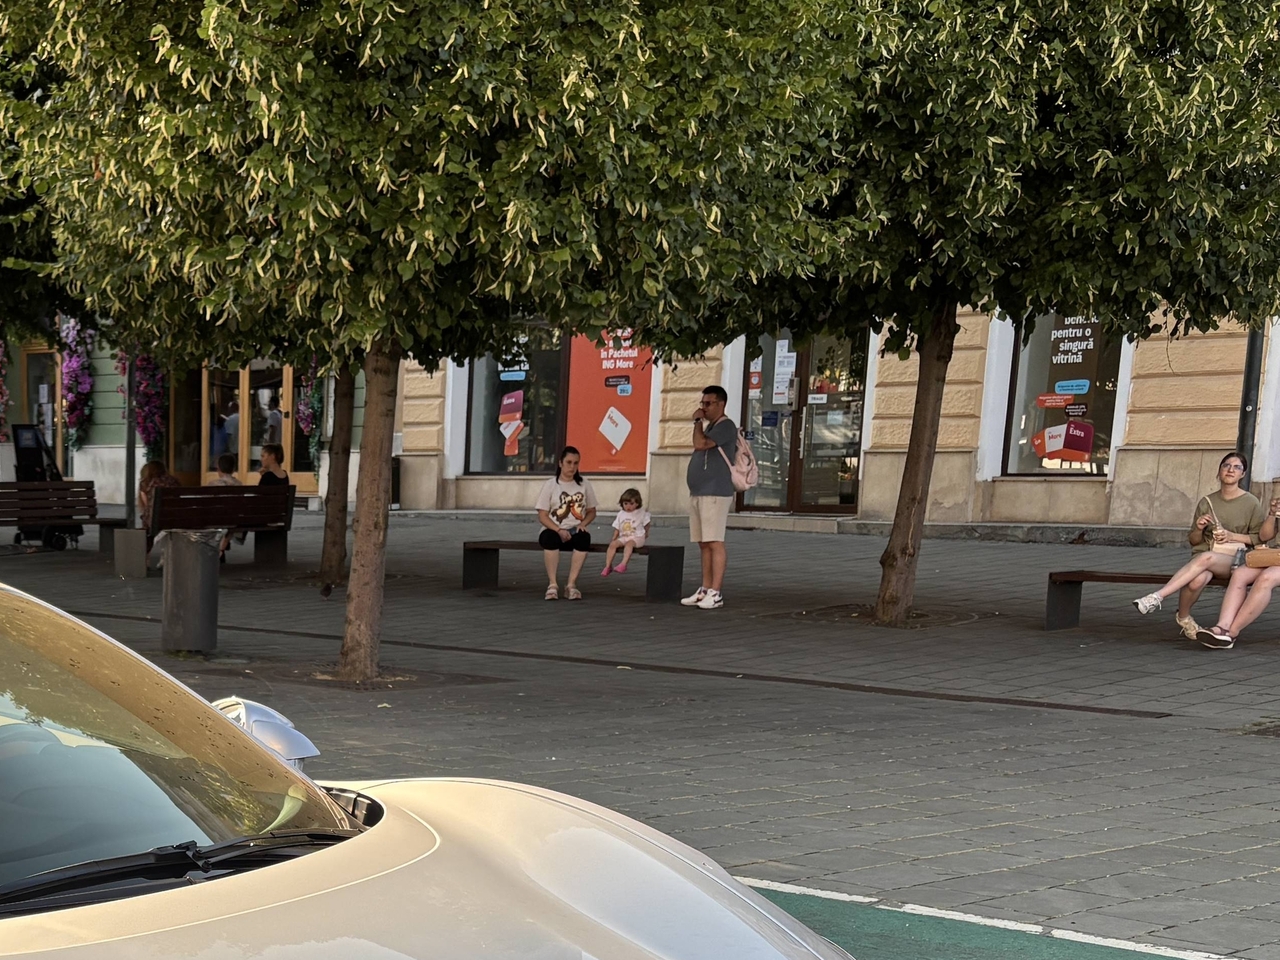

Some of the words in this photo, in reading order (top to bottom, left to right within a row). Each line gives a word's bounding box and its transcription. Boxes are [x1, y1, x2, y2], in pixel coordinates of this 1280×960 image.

[1051, 327, 1083, 341] pentru
[1085, 328, 1091, 336] o
[1059, 338, 1094, 353] singură
[608, 347, 638, 358] Pachetul
[1052, 352, 1083, 364] vitrină
[602, 360, 615, 369] ING
[616, 359, 634, 369] More
[1069, 427, 1085, 437] Extra
